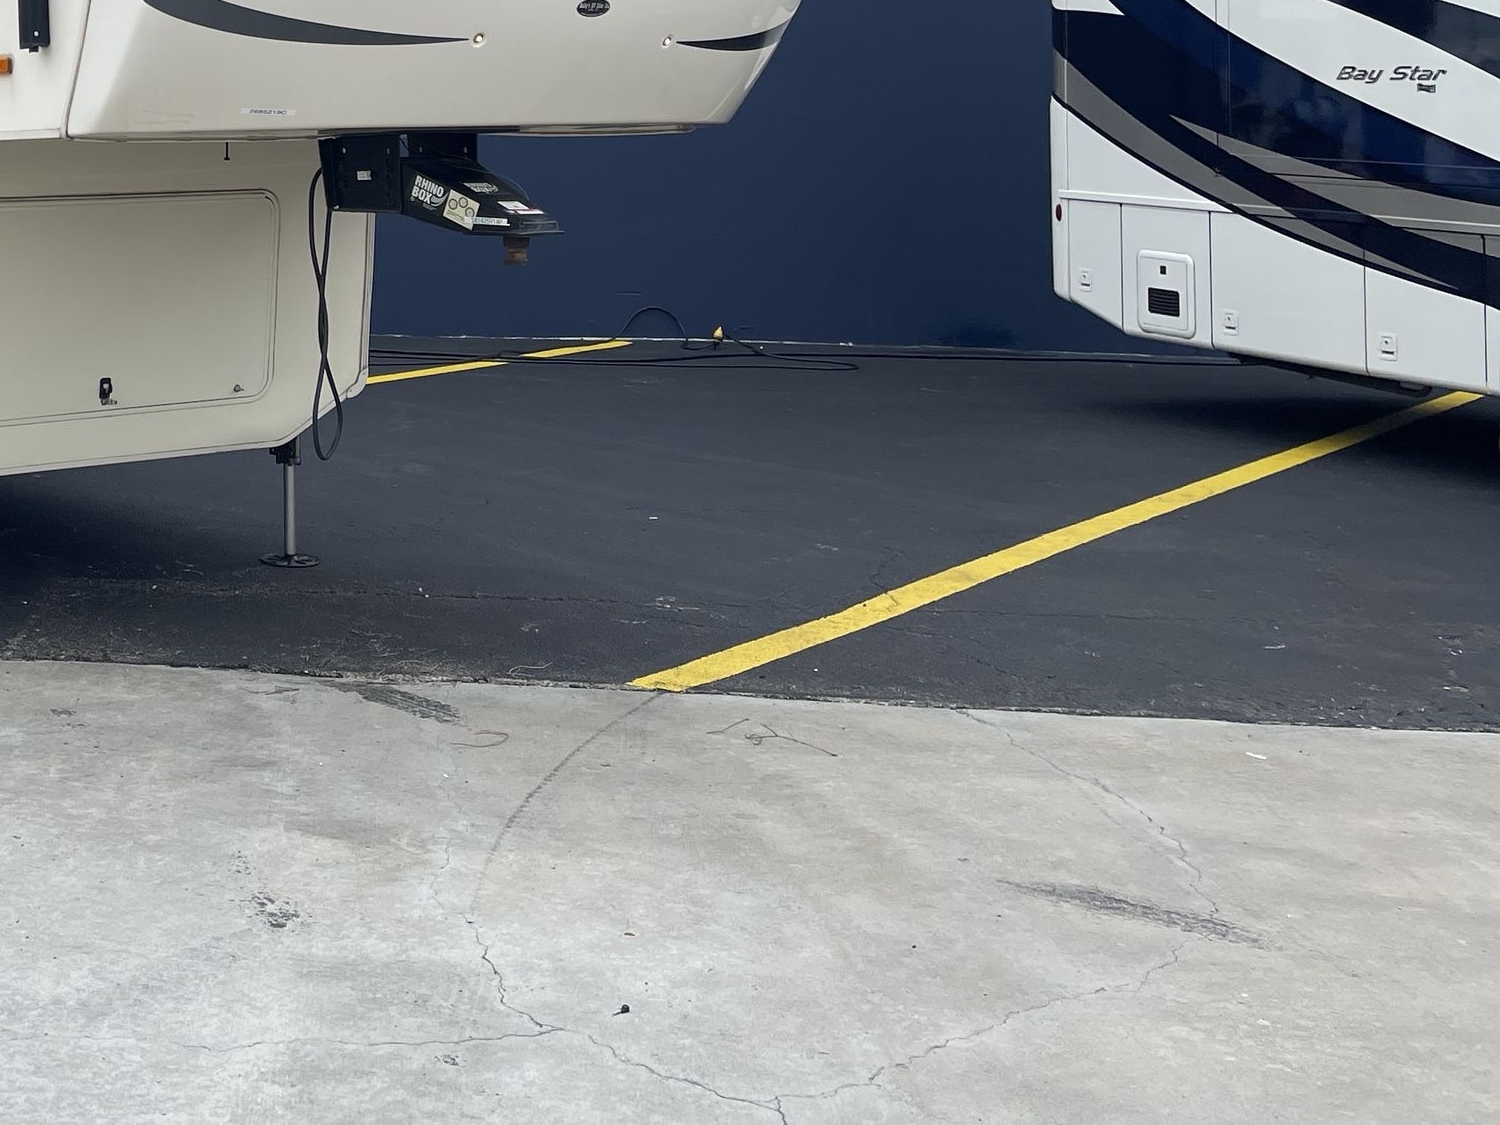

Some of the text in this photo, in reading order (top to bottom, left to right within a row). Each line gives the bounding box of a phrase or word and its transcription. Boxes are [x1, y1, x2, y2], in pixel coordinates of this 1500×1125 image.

[1336, 65, 1448, 84] Bay Star
[411, 185, 432, 205] BOX
[414, 174, 445, 197] RHINO
